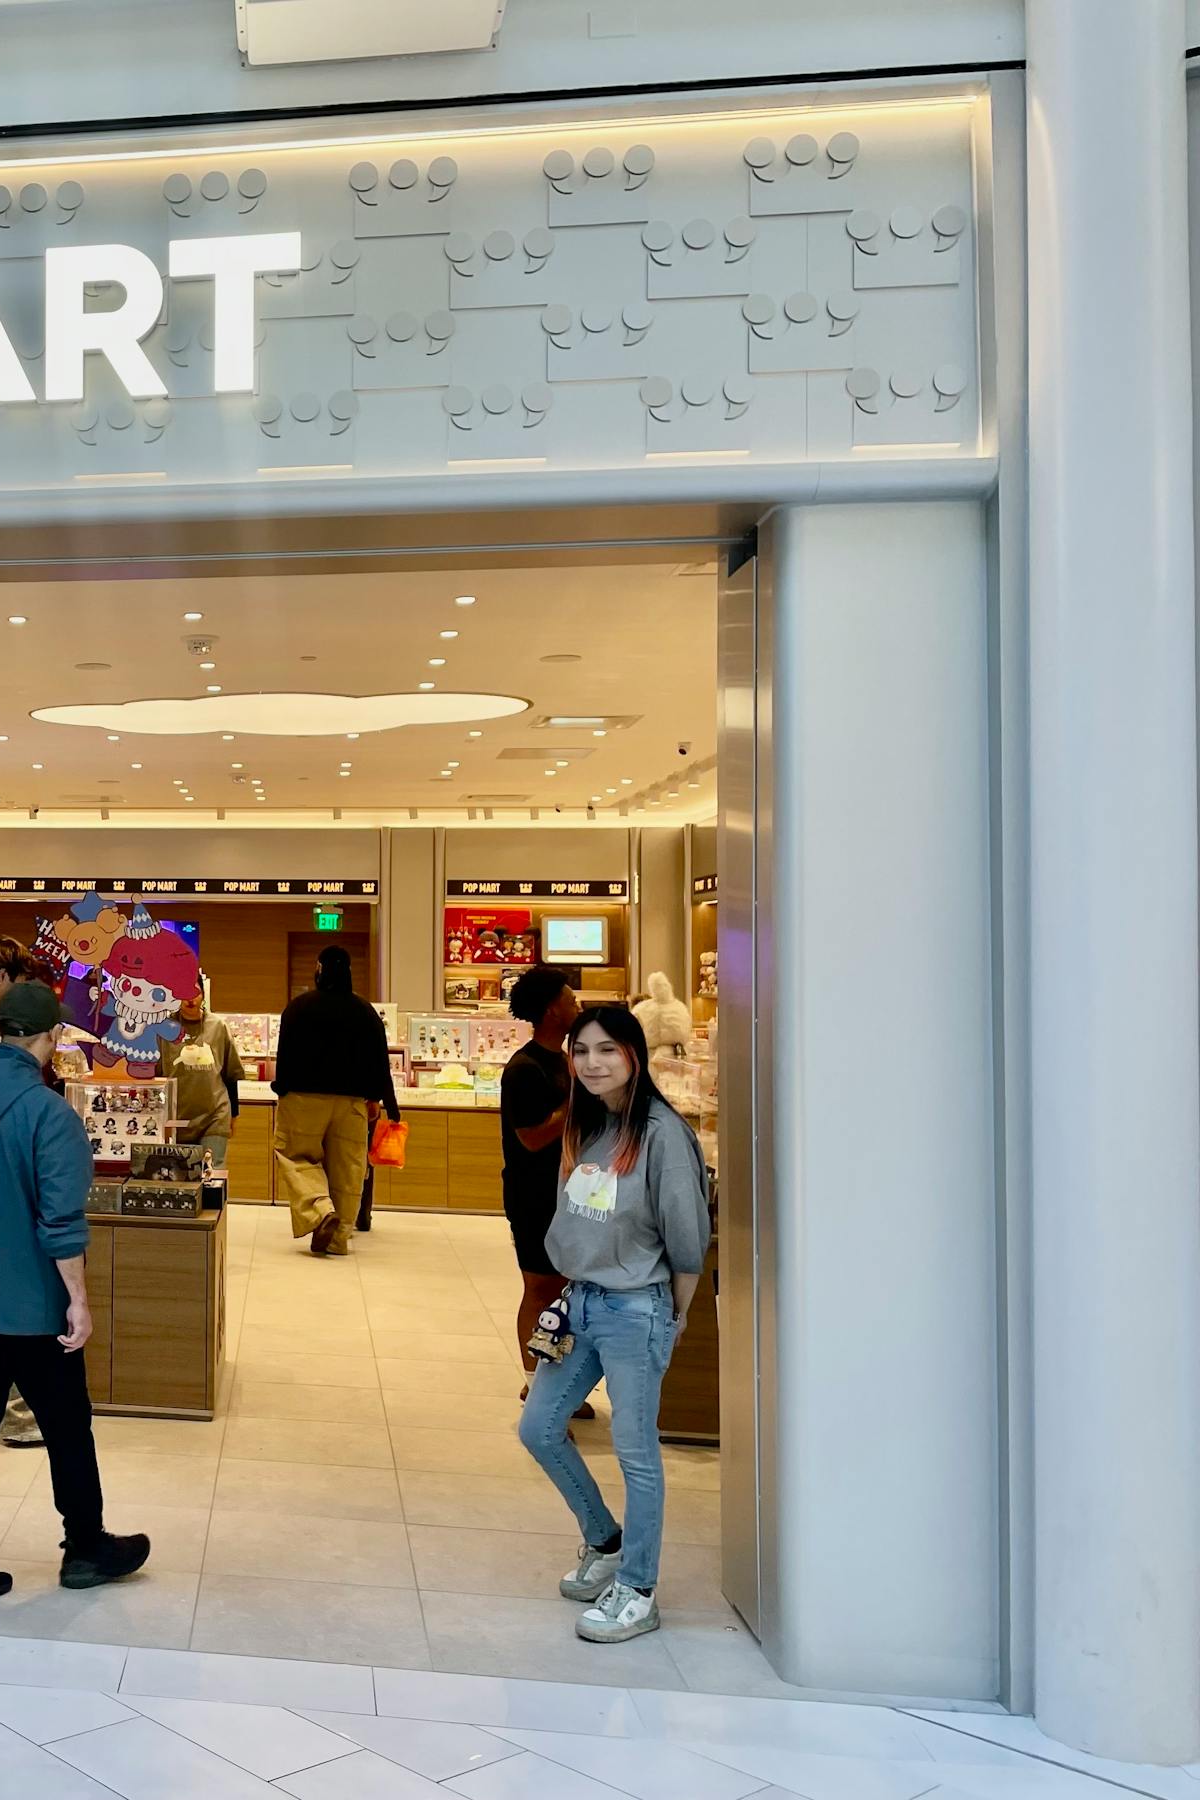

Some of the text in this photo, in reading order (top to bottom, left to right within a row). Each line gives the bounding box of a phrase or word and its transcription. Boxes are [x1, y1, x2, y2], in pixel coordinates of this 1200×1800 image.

[61, 880, 76, 891] POP
[76, 880, 97, 891] MART
[141, 880, 157, 892] POP
[157, 881, 178, 892] MART
[223, 881, 239, 892] POP
[239, 881, 260, 892] MART
[307, 881, 323, 893] POP
[323, 882, 345, 893] MART
[462, 882, 590, 894] POP MART POP MART
[318, 914, 339, 930] EXIT
[35, 936, 71, 963] WEEN
